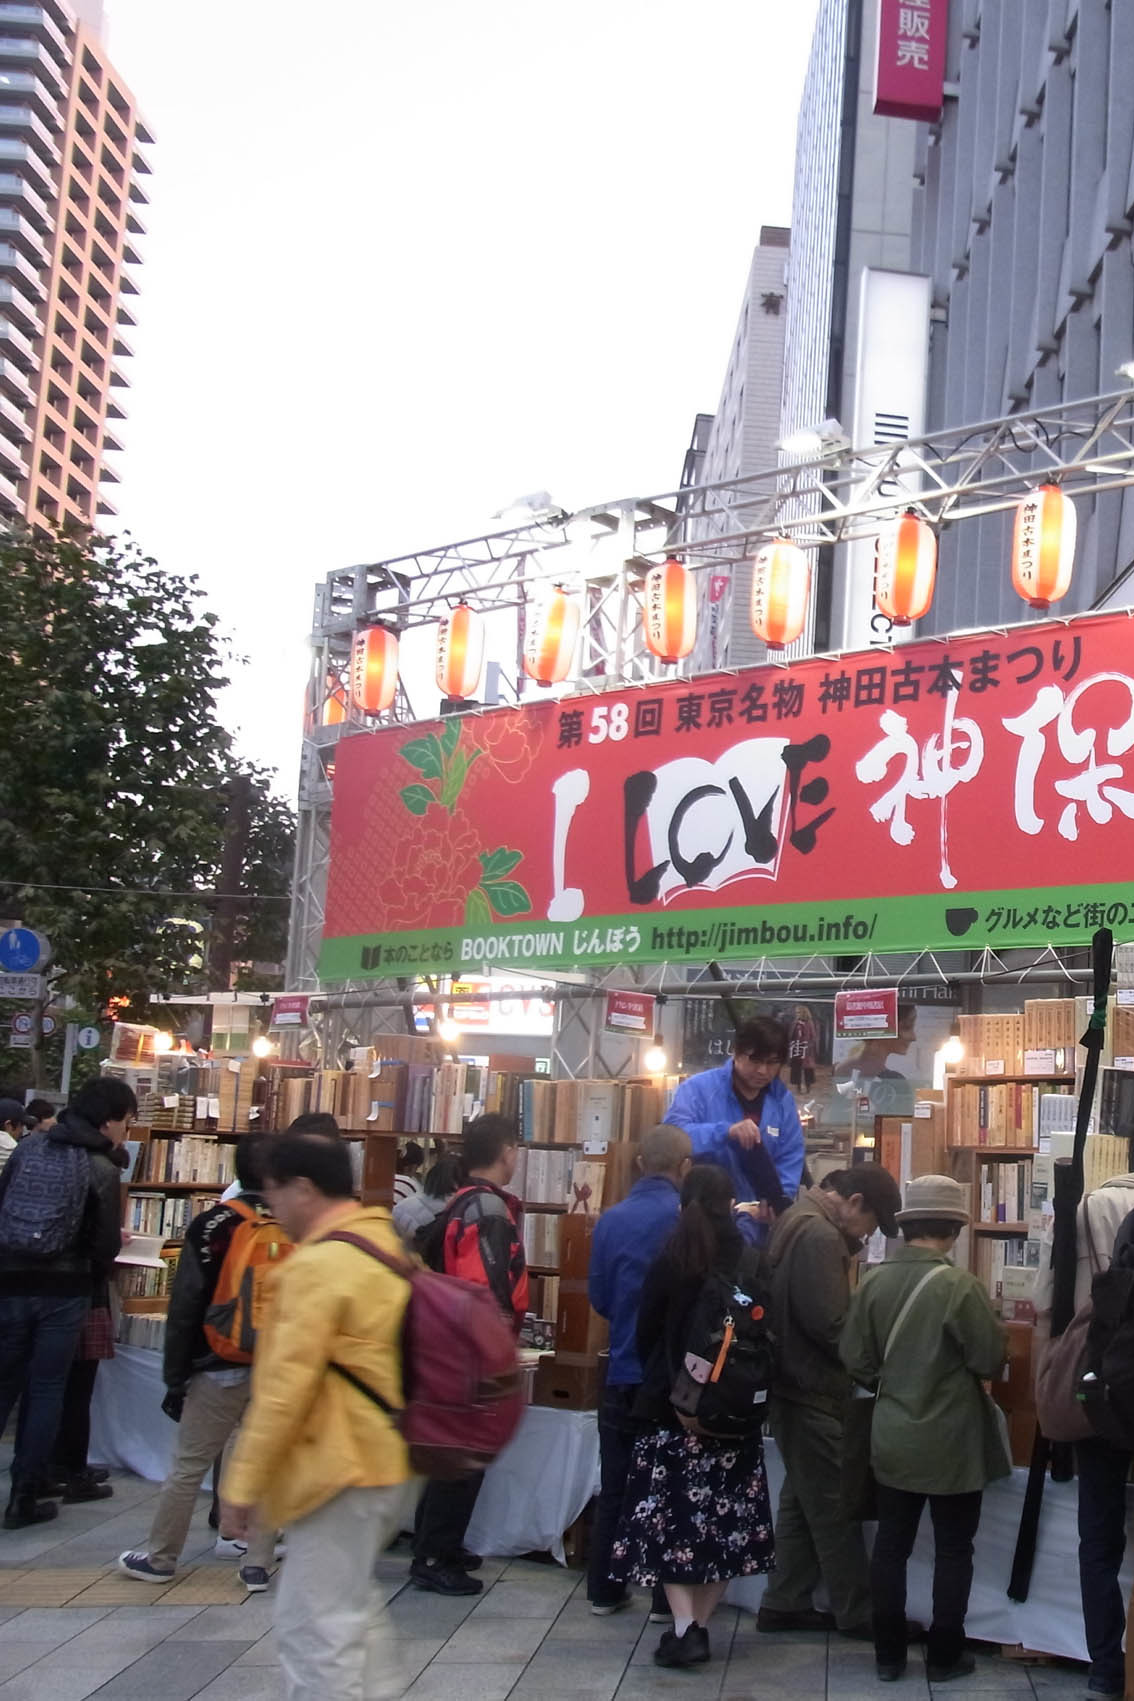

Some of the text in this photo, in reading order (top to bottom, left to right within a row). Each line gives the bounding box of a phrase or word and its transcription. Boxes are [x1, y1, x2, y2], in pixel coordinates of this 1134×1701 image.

[1020, 502, 1038, 581] 神田古本まつり
[556, 635, 1084, 751] 第58回 東京名物 神田古本まつり
[624, 733, 836, 906] LOVE
[383, 939, 454, 968] 本のことなら
[460, 930, 565, 962] BOOKTOWN
[651, 912, 879, 955] http://jimbou.info/
